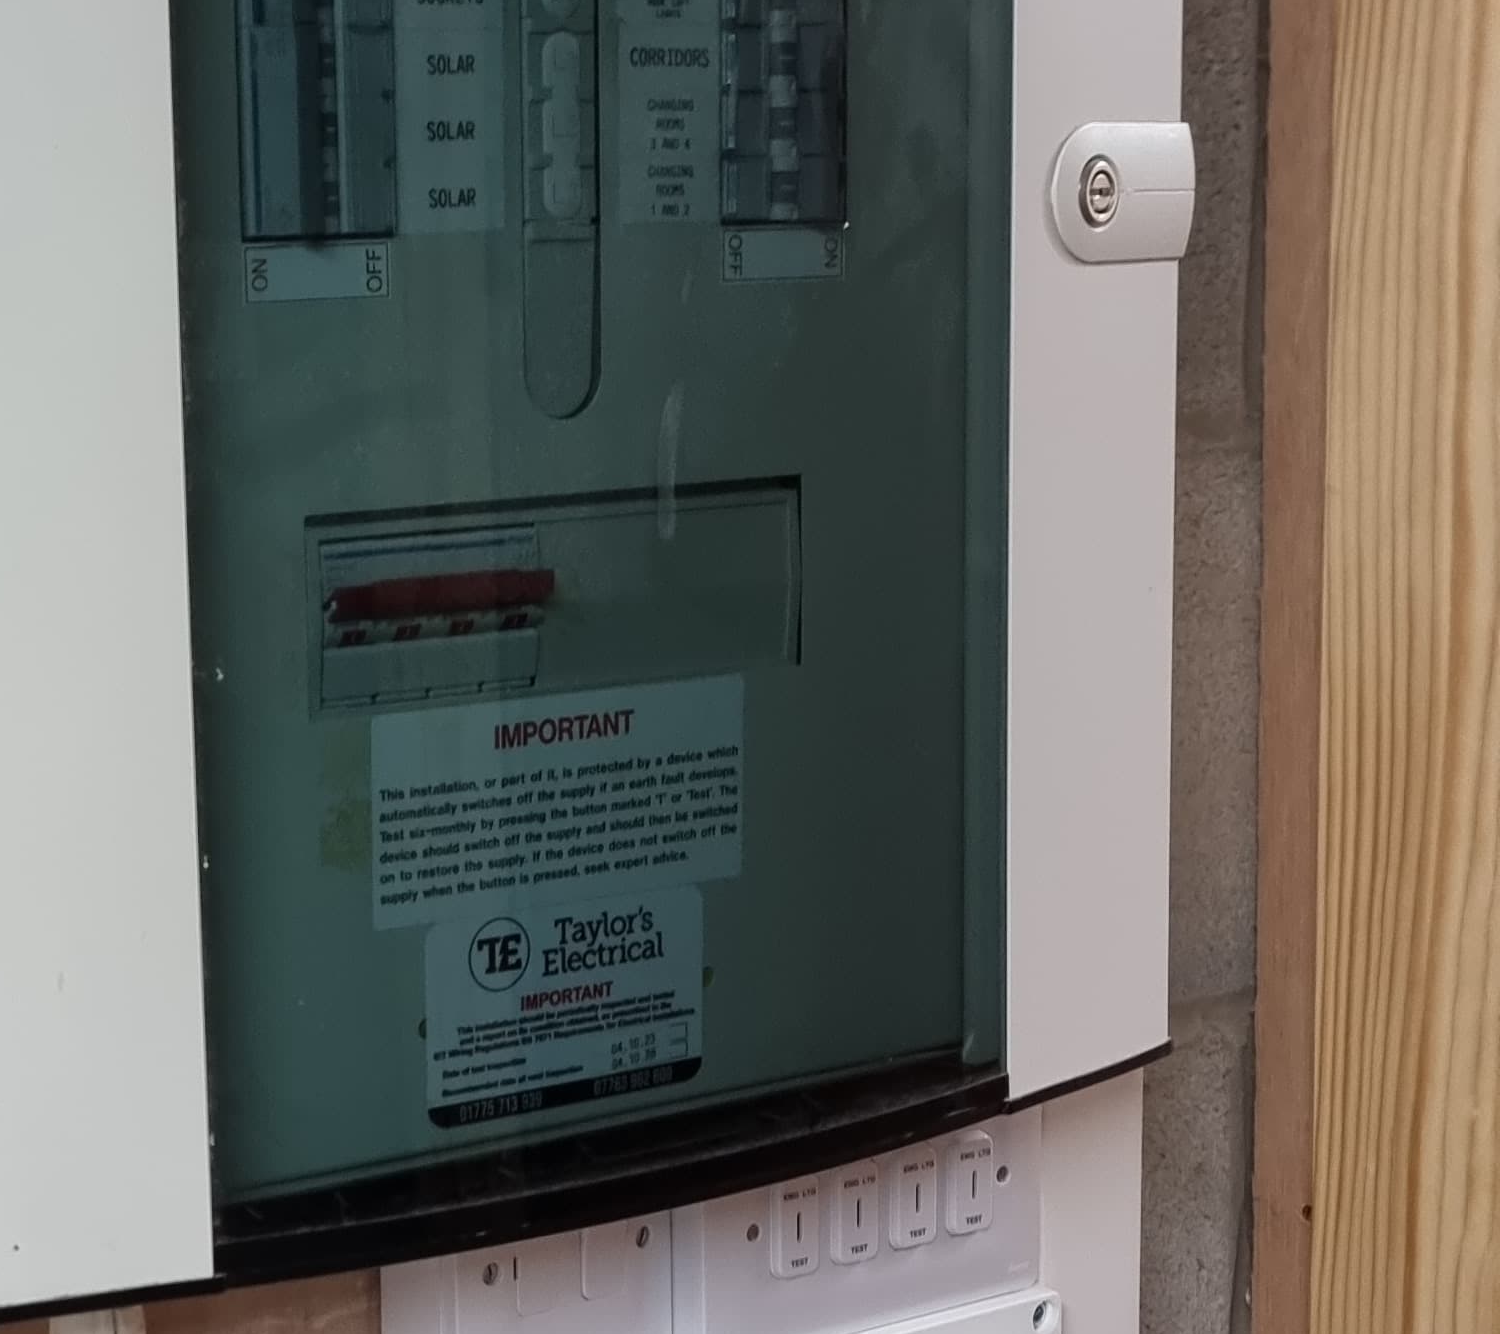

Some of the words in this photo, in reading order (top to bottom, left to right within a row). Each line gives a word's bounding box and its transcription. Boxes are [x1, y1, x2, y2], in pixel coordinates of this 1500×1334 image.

[426, 53, 476, 76] SOLAR
[630, 47, 709, 68] CORRIDORS
[426, 120, 477, 143] SOLAR
[428, 187, 477, 210] SOLAR
[728, 234, 743, 276] OFF
[824, 238, 839, 269] ON
[250, 258, 268, 292] ON
[366, 248, 383, 293] OFF
[494, 709, 635, 750] IMPORTANT
[379, 787, 404, 802] This
[483, 778, 496, 789] or
[500, 772, 525, 789] part
[529, 768, 542, 782] of
[546, 768, 558, 781] it,
[576, 757, 633, 779] protected
[636, 757, 650, 770] by
[655, 756, 662, 766] a
[666, 750, 703, 765] device
[707, 744, 738, 759] which
[554, 905, 654, 948] Taylor's
[476, 933, 524, 975] TE
[542, 930, 664, 977] Electrical
[520, 981, 614, 1011] IMPORTANT
[910, 1228, 926, 1239] TEST
[966, 1214, 982, 1225] TEST
[791, 1257, 808, 1268] TEST
[851, 1243, 867, 1254] TEST
